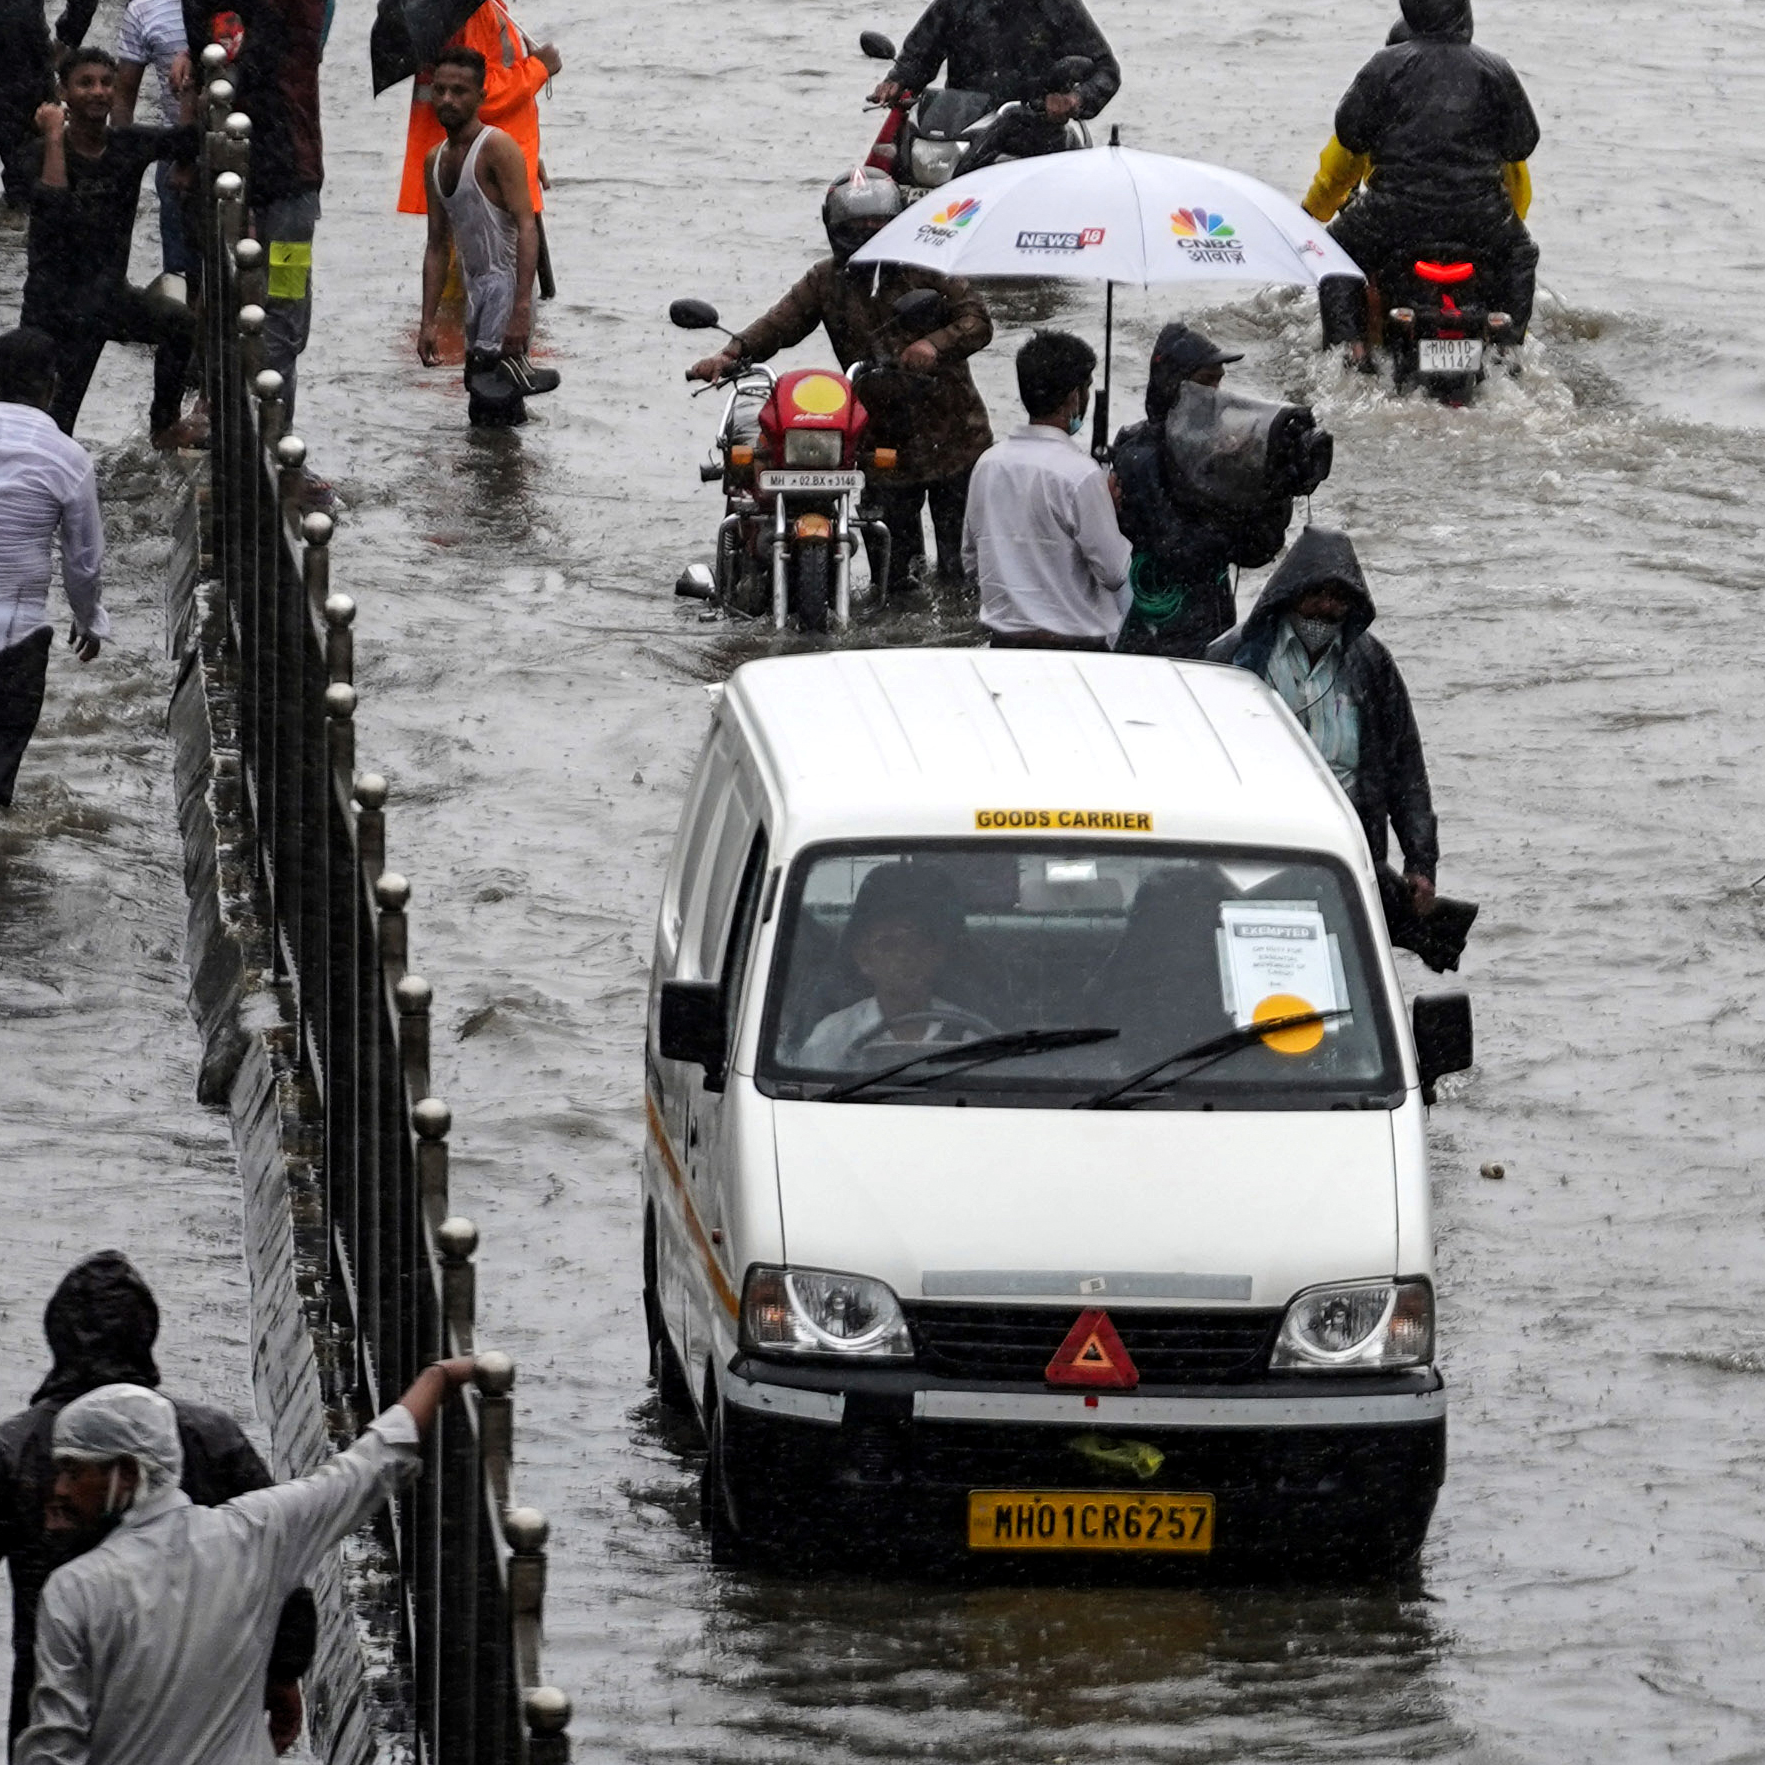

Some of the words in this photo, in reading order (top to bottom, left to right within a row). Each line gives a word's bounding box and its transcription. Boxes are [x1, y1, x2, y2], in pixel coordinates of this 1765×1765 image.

[918, 224, 959, 239] CNBC
[1019, 233, 1079, 247] NEWS
[1177, 238, 1244, 250] CNBC
[1187, 249, 1246, 265] आवाज़
[770, 476, 785, 485] MH
[977, 811, 1051, 827] GOODS
[1058, 811, 1151, 830] CARRIER
[1241, 925, 1310, 937] EXEMPTED
[995, 1503, 1208, 1540] MH01CR6257
